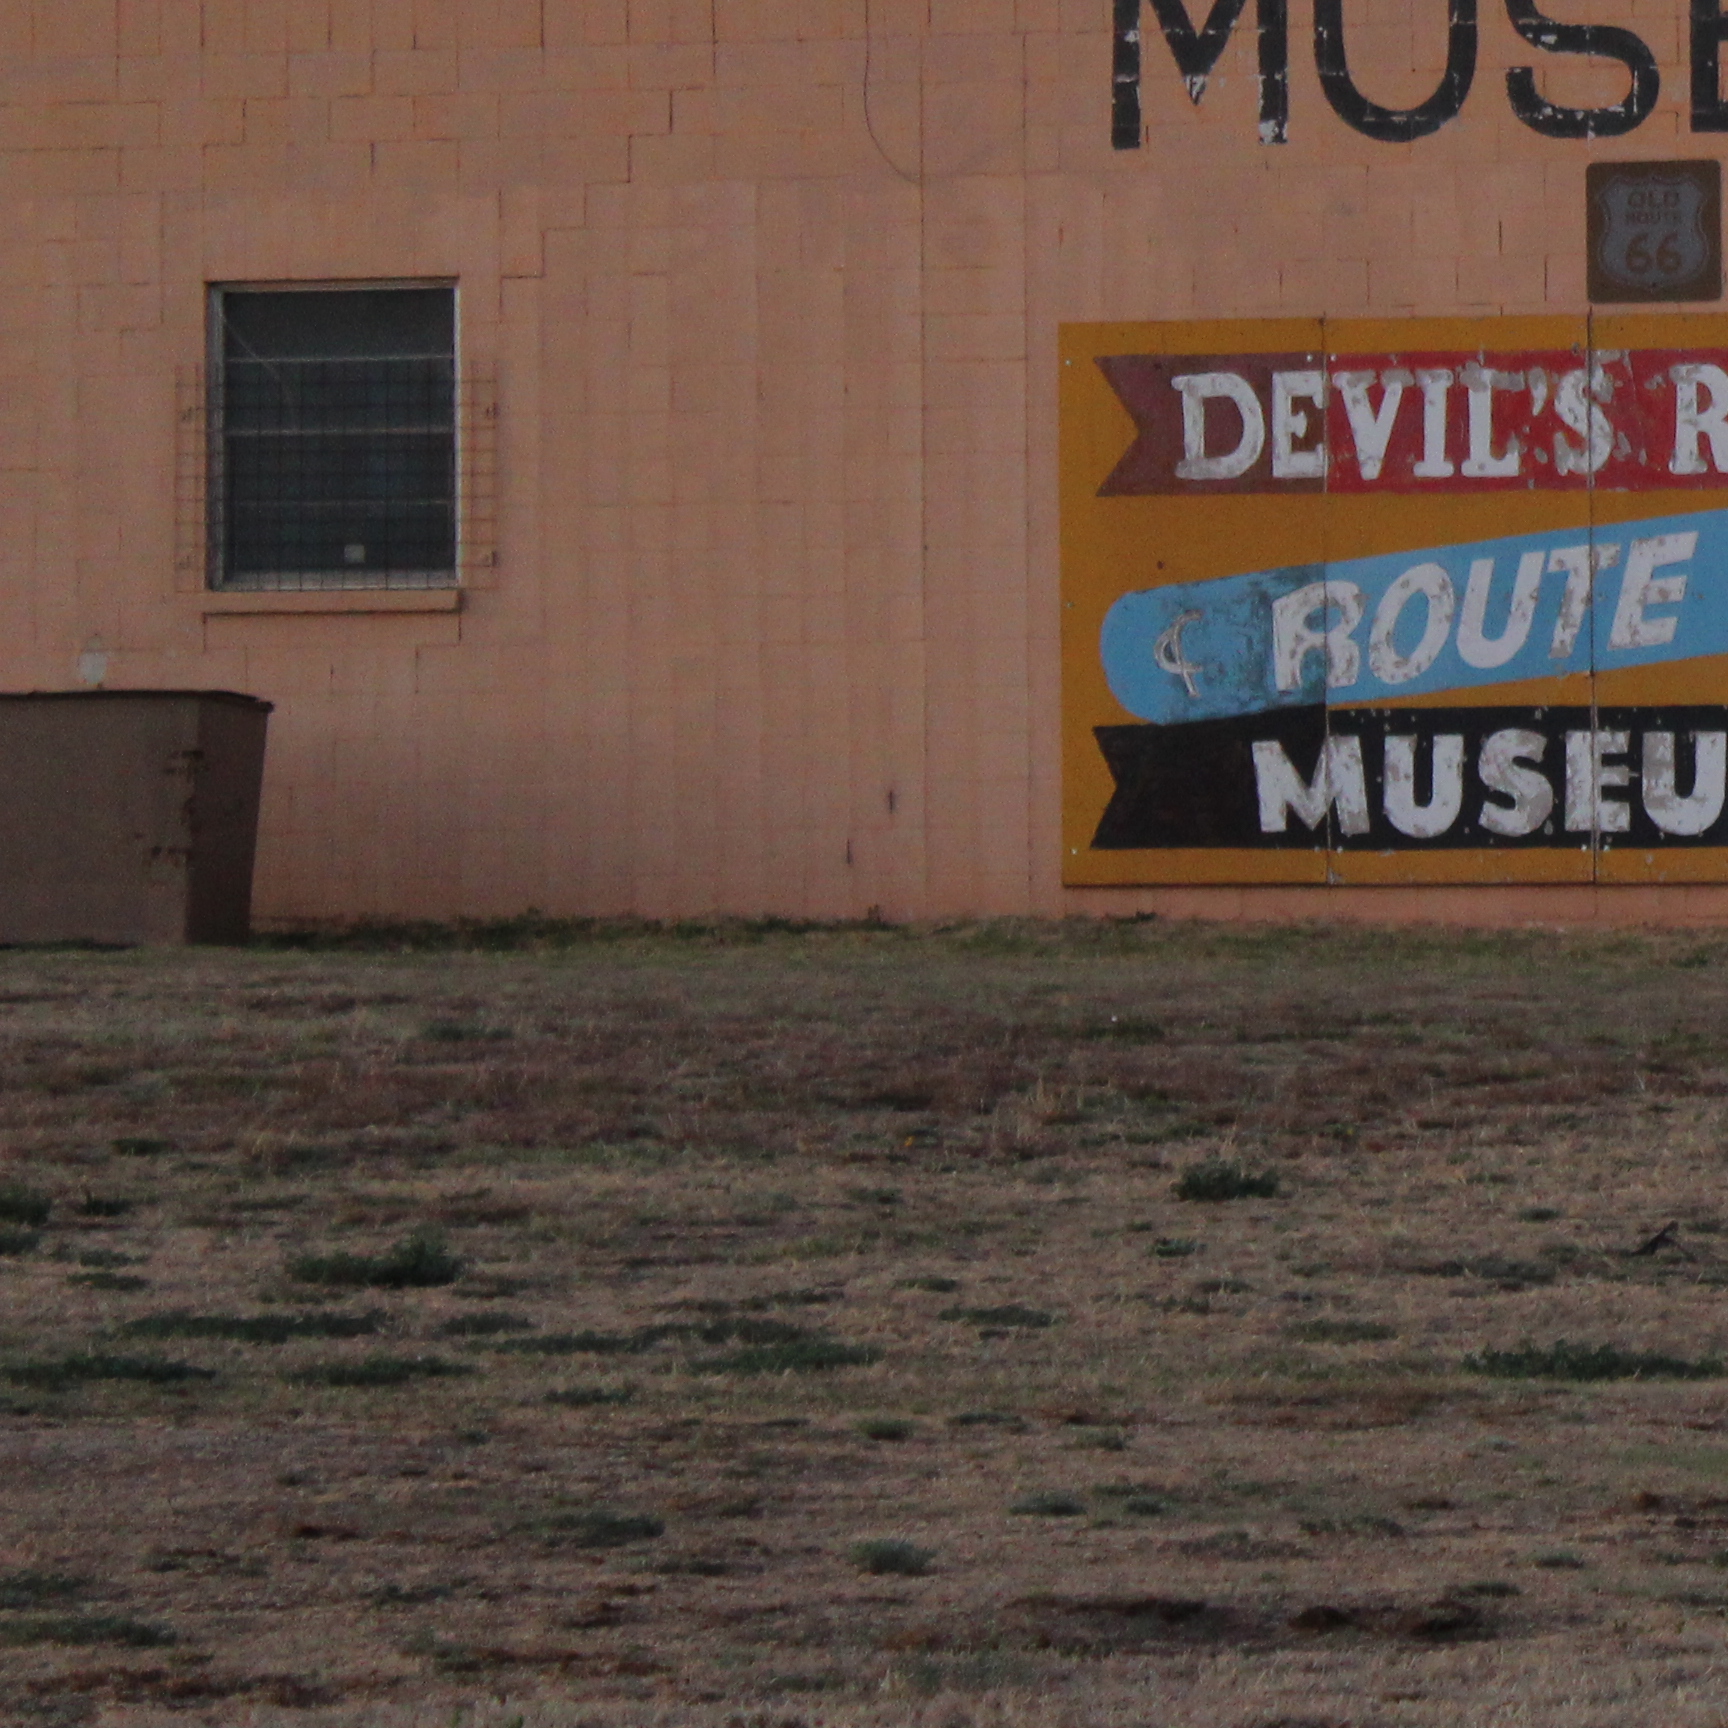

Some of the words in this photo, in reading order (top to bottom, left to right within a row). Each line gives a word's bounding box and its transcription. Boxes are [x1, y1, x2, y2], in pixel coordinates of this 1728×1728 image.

[1628, 190, 1680, 208] OLD
[1625, 233, 1682, 274] 66
[1172, 368, 1620, 480] DEVIL'S
[1271, 532, 1698, 693] ROUTE
